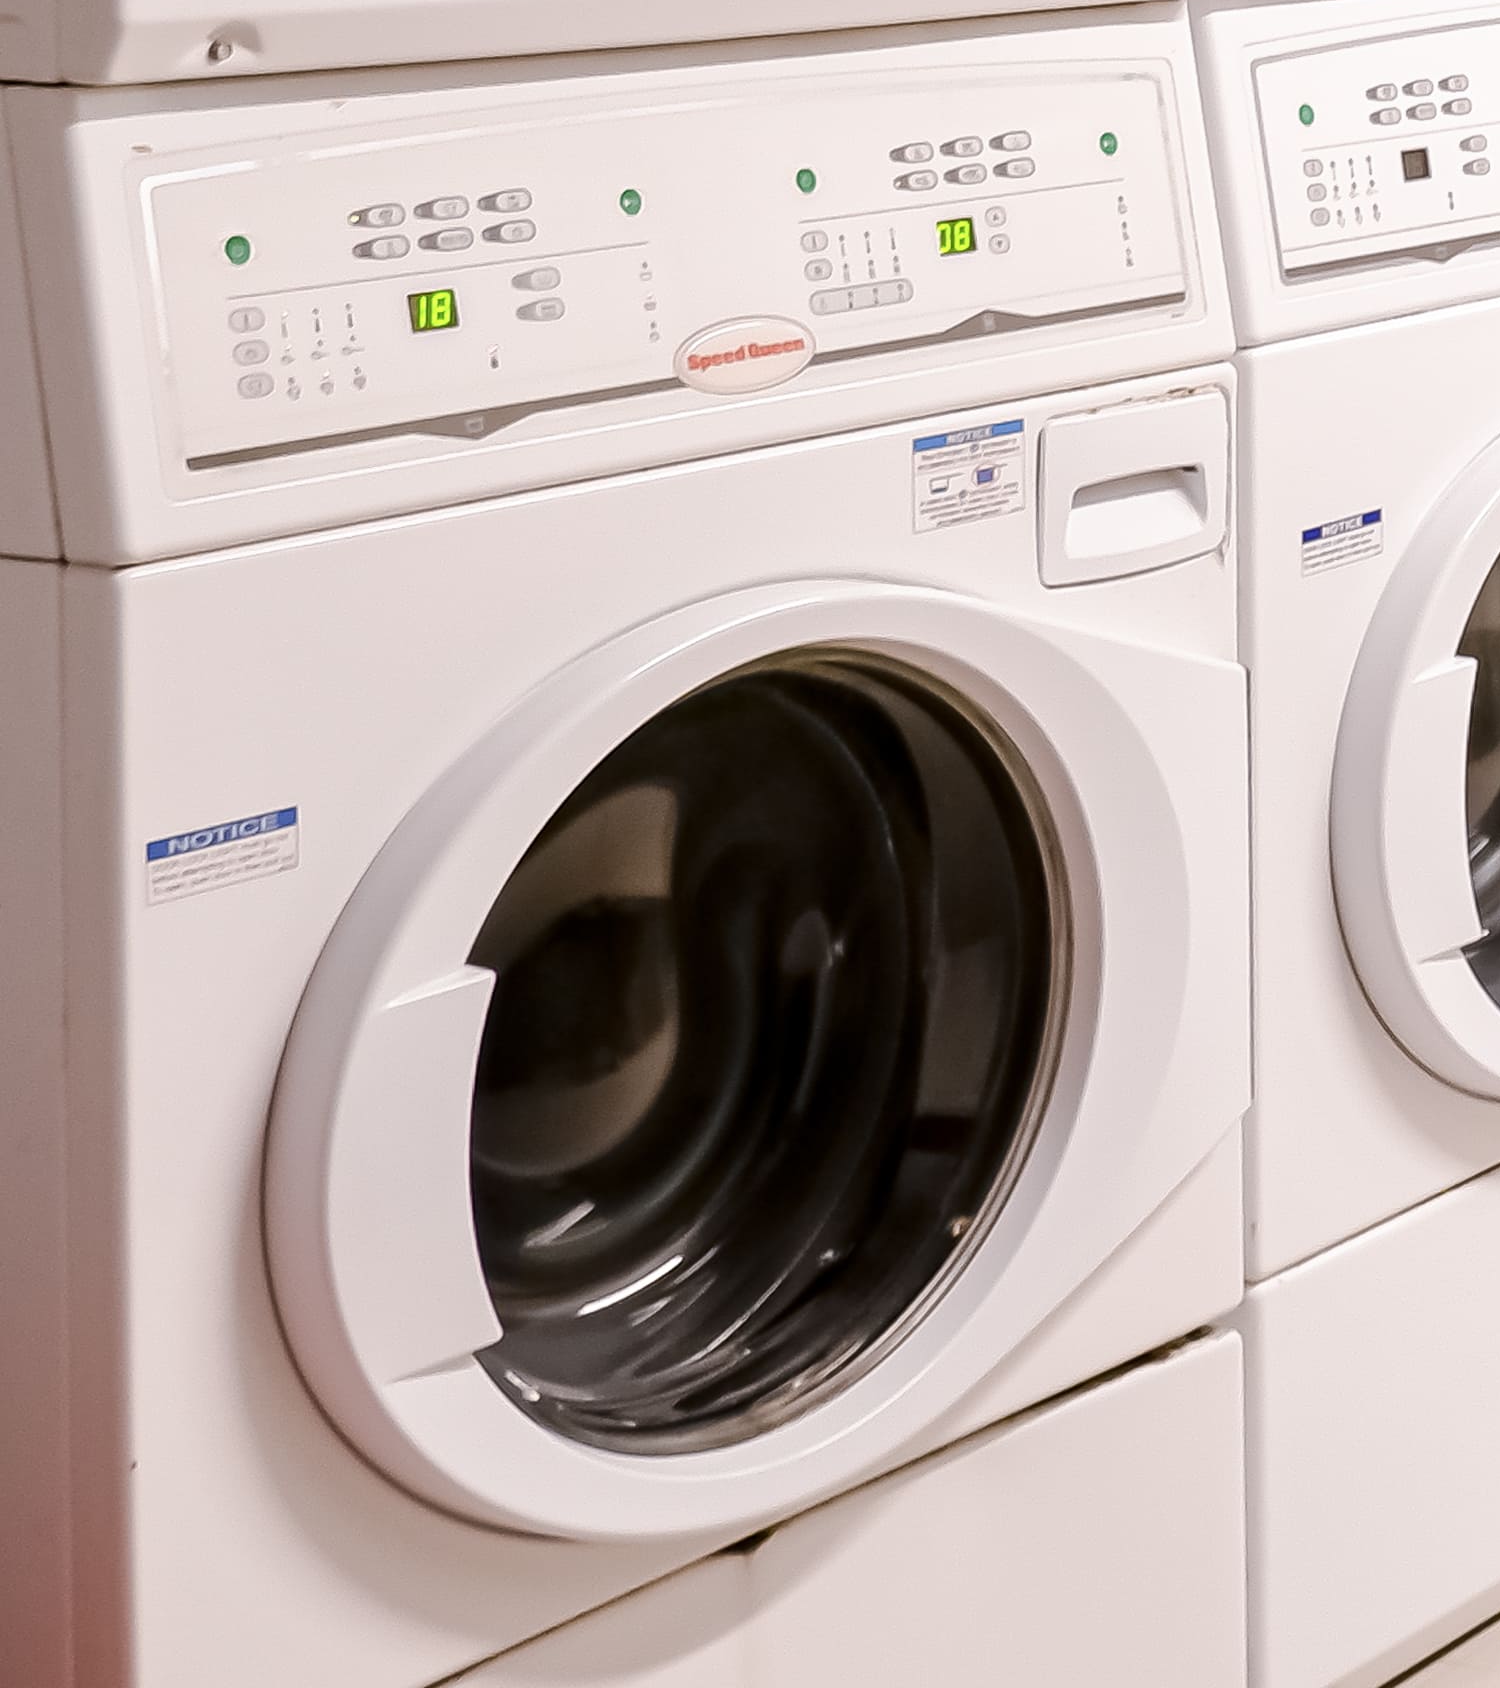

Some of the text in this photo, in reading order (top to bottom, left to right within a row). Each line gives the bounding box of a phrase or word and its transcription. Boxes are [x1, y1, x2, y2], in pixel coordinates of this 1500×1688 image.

[419, 291, 451, 329] 18
[687, 345, 746, 372] Speed
[167, 812, 279, 855] NOTICE
